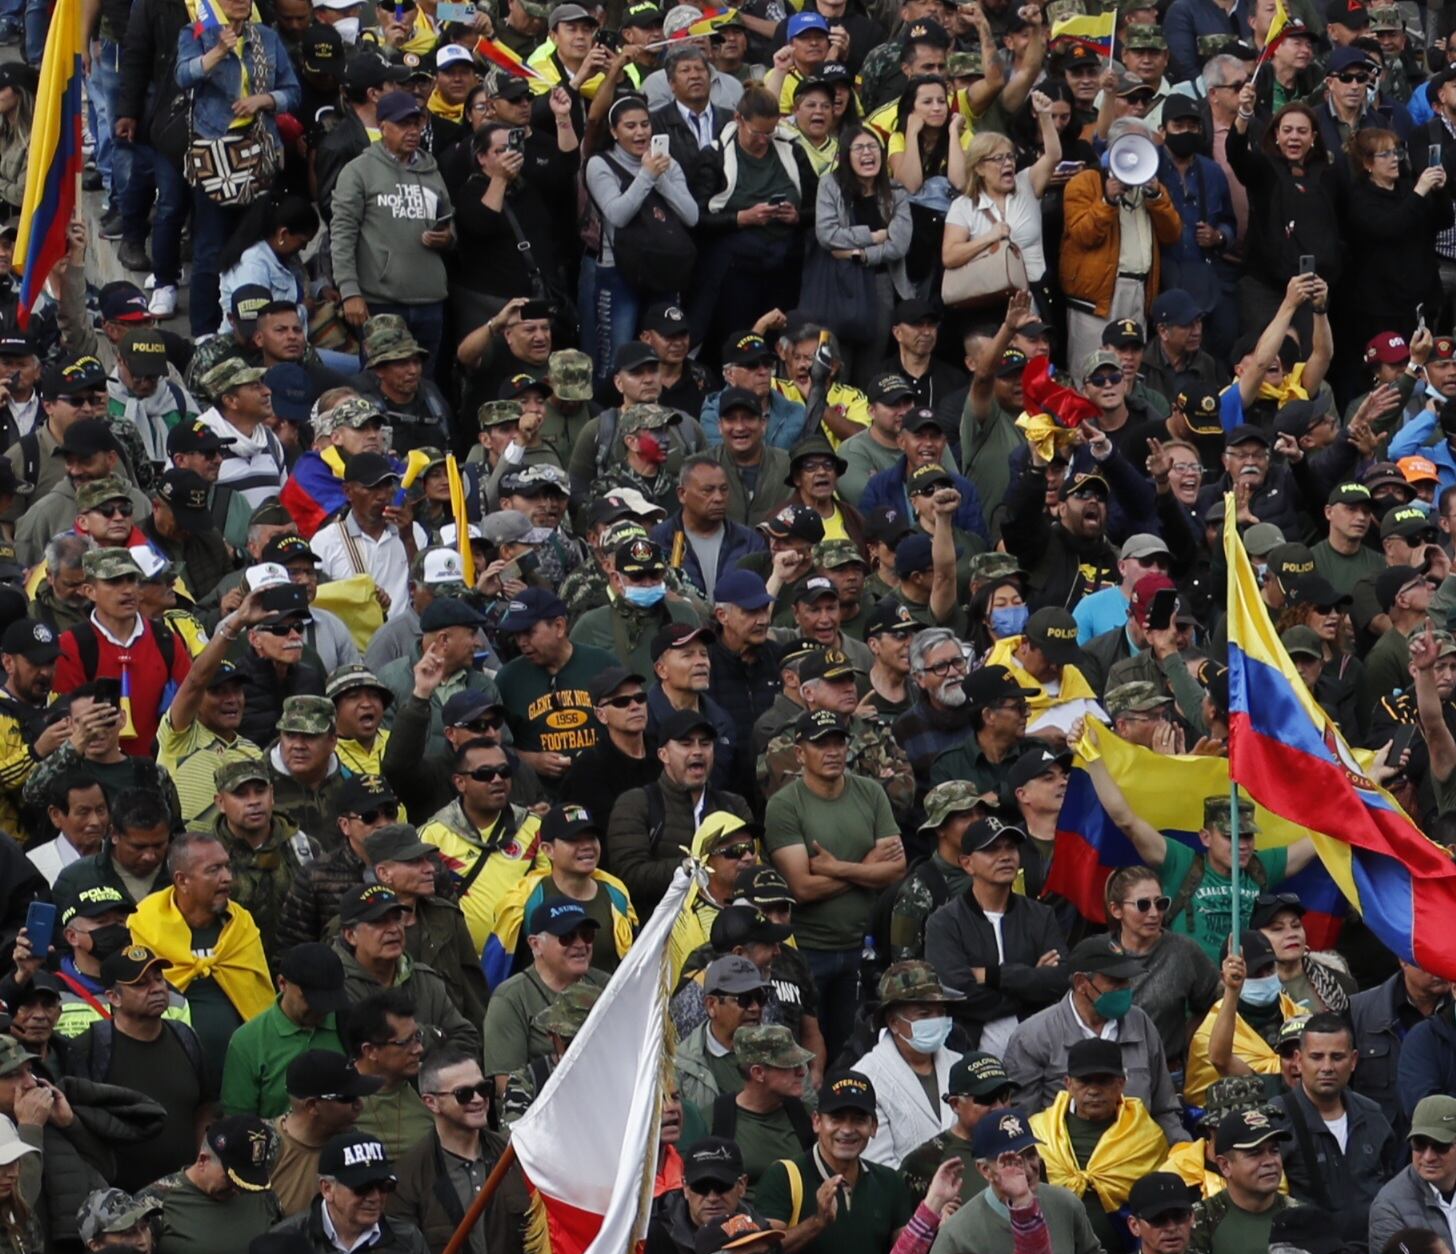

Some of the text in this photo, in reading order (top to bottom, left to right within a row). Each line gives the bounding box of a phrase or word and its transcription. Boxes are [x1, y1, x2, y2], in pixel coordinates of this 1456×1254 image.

[395, 184, 420, 197] THE
[377, 194, 424, 207] NORTH
[1047, 626, 1077, 640] POLIC
[555, 711, 578, 726] 1956
[360, 886, 395, 901] VETERANO
[832, 1080, 868, 1091] VETERANO
[343, 1142, 383, 1166] ARMY
